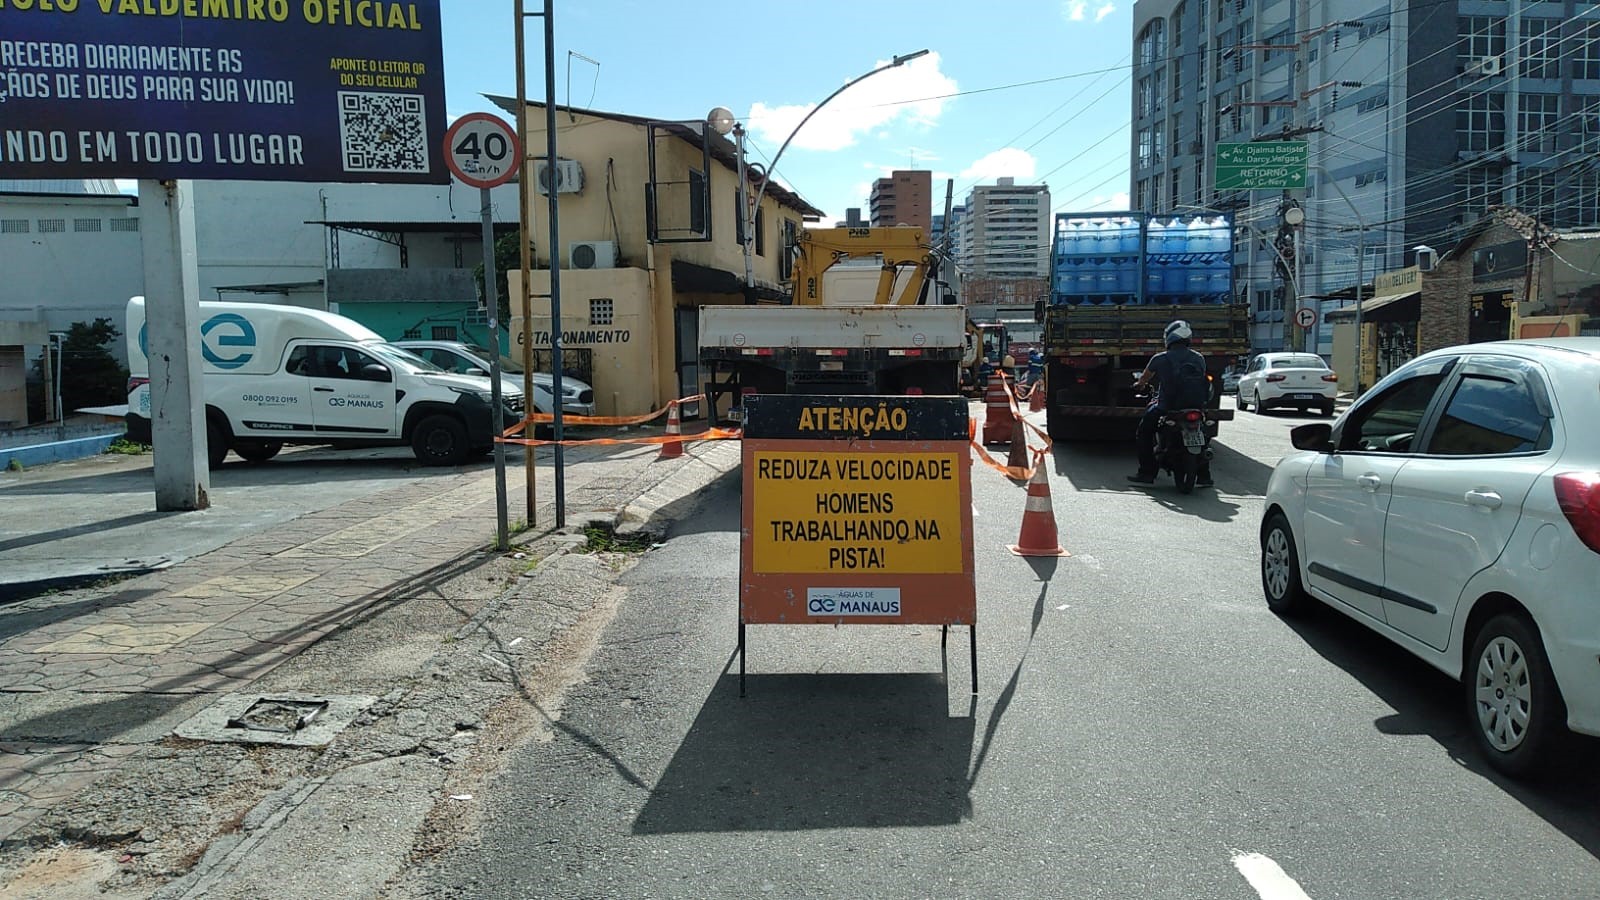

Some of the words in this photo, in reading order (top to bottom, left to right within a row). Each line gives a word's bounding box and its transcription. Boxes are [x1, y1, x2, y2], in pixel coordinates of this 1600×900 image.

[303, 0, 422, 30] OFICIAL
[1, 41, 79, 68] RECEBA
[85, 43, 212, 72] DIARIAMENTE
[217, 49, 242, 73] AS
[330, 58, 367, 71] APONTE
[371, 60, 377, 71] O
[378, 60, 411, 74] LEITOR
[413, 63, 425, 74] QR
[56, 74, 81, 98] DE
[87, 75, 137, 99] DEUS
[143, 77, 194, 101] PARA
[200, 78, 239, 102] SUA
[243, 79, 294, 104] VIDA!
[340, 73, 352, 85] DO
[356, 74, 374, 86] SEU
[376, 76, 418, 88] CELULAR
[0, 130, 67, 162] NDO
[78, 131, 117, 162] EM
[126, 132, 203, 162] TODO
[213, 133, 304, 165] LUGAR
[456, 132, 507, 160] 40
[1240, 168, 1288, 177] RETORNO
[242, 394, 264, 402] 0800
[347, 399, 384, 409] MANAUS
[798, 402, 908, 436] ATENÇÃO
[759, 458, 832, 480] REDUZA
[836, 459, 952, 481] VELOCIDADE
[816, 492, 894, 514] HOMENS
[771, 519, 909, 542] TRABALHANDO
[914, 519, 941, 540] NA
[829, 547, 885, 569] PISTA!
[865, 591, 875, 599] DE
[839, 601, 900, 613] MANAUS
